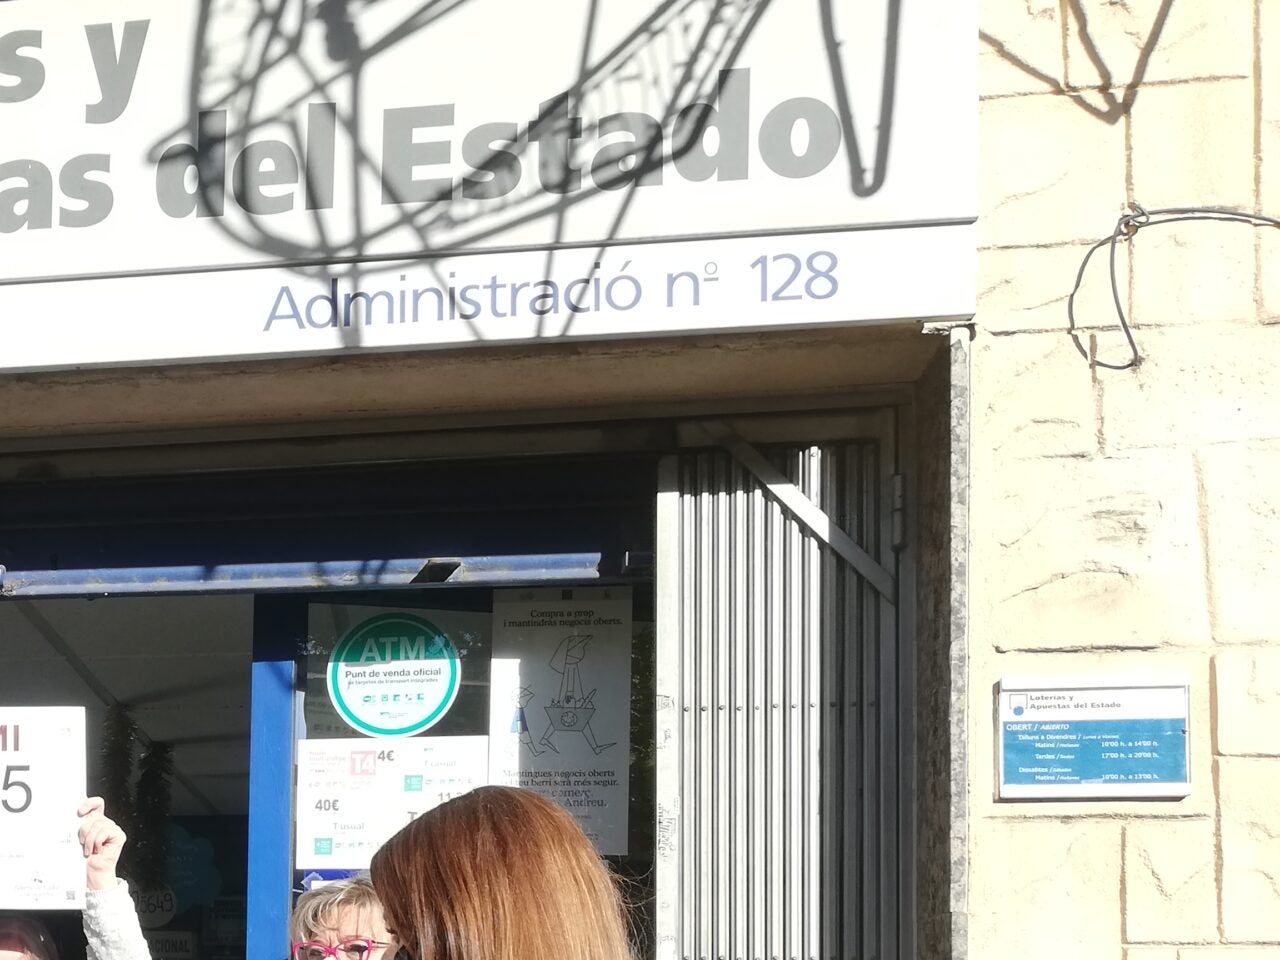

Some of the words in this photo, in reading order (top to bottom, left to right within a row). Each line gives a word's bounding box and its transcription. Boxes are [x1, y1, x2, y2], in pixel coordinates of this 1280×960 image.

[84, 18, 151, 124] y
[155, 102, 336, 219] del
[381, 68, 842, 207] Estado
[263, 261, 642, 331] Administració
[750, 250, 839, 302] 128
[530, 609, 564, 618] Compra
[574, 609, 594, 618] prop
[508, 618, 557, 627] mantindràs
[559, 618, 591, 627] negocis
[593, 616, 623, 625] oberts.
[358, 635, 425, 664] ATM
[345, 670, 366, 679] Punt
[369, 669, 380, 677] de
[383, 668, 411, 677] venda
[413, 667, 441, 676] oficial
[1029, 702, 1070, 710] Apuestas
[1091, 701, 1121, 709] Estado
[377, 750, 395, 762] 4€
[554, 769, 586, 779] negocis
[587, 768, 615, 778] oberts
[593, 779, 620, 787] segur.
[315, 799, 340, 811] 40€
[564, 798, 607, 807] Andreu.
